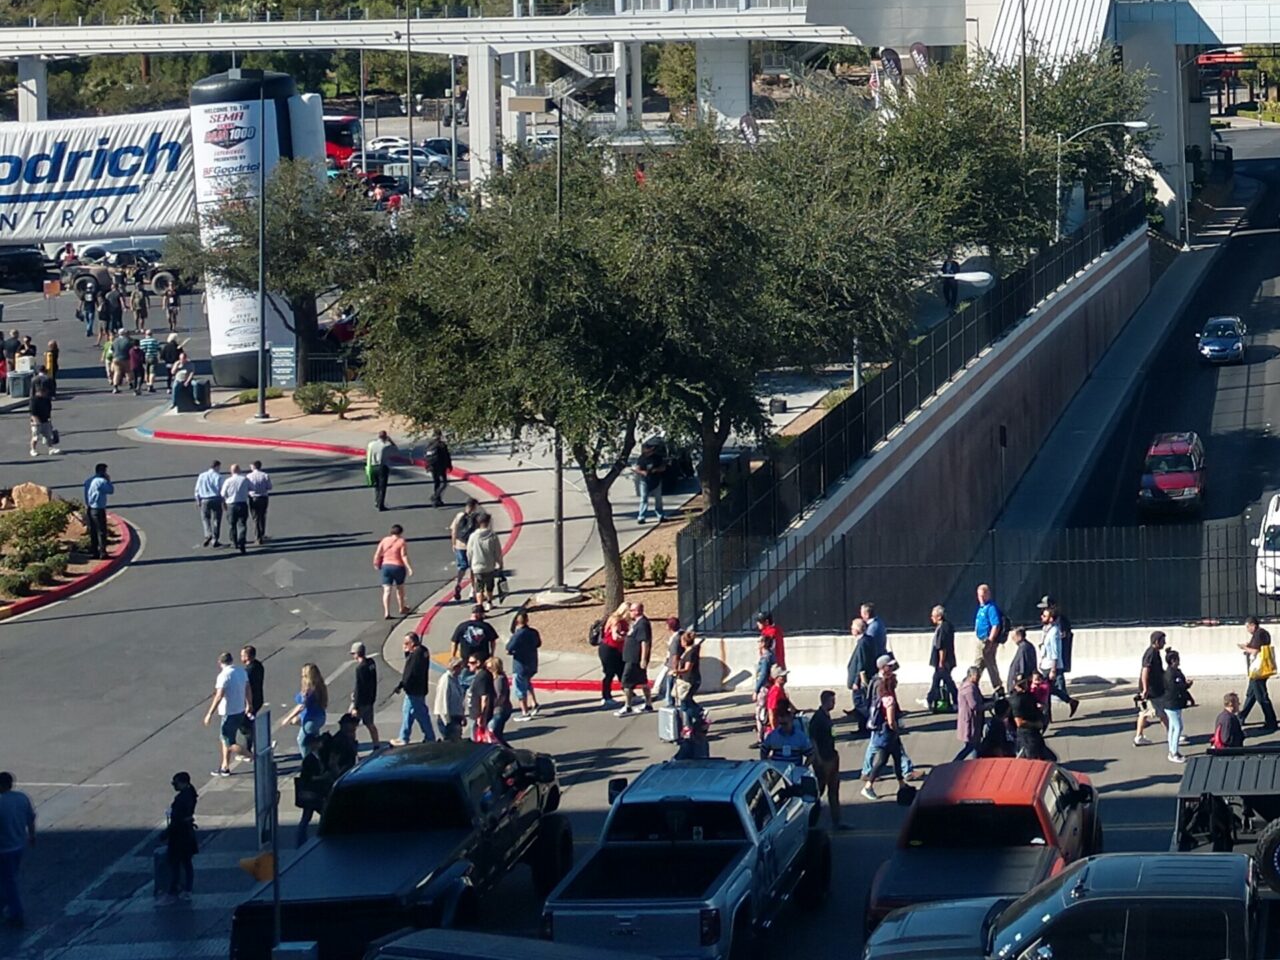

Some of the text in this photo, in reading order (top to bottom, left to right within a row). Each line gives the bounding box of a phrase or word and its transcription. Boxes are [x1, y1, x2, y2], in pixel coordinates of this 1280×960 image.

[204, 106, 228, 114] WELCOME
[209, 111, 244, 124] SEMA
[229, 126, 256, 140] 1000
